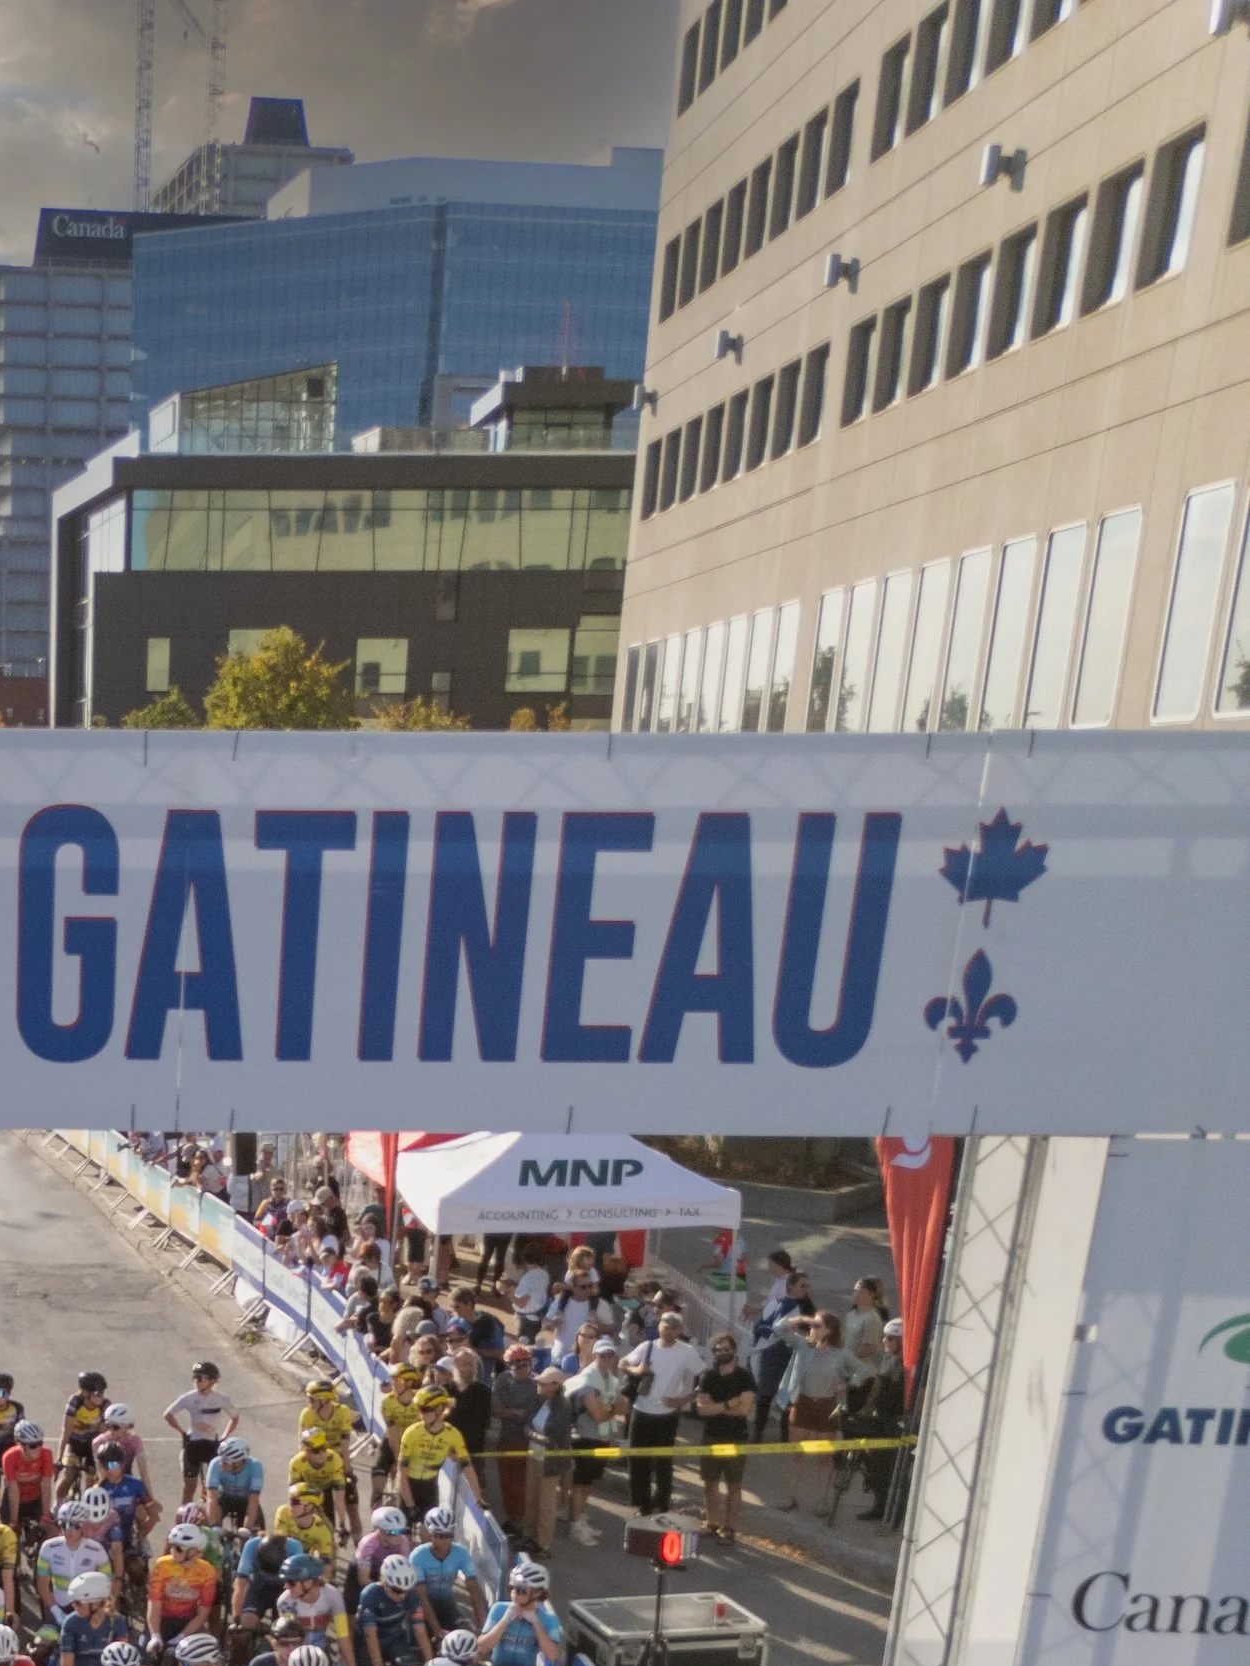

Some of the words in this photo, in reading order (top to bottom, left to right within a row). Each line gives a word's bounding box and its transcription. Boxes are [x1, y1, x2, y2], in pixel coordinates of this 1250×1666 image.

[53, 214, 125, 240] Canada
[15, 803, 903, 1069] GATINEAU
[518, 1159, 644, 1187] MNP
[477, 1209, 559, 1221] ACCOUNTING
[579, 1207, 657, 1220] CONSULTING
[678, 1206, 701, 1217] TAX
